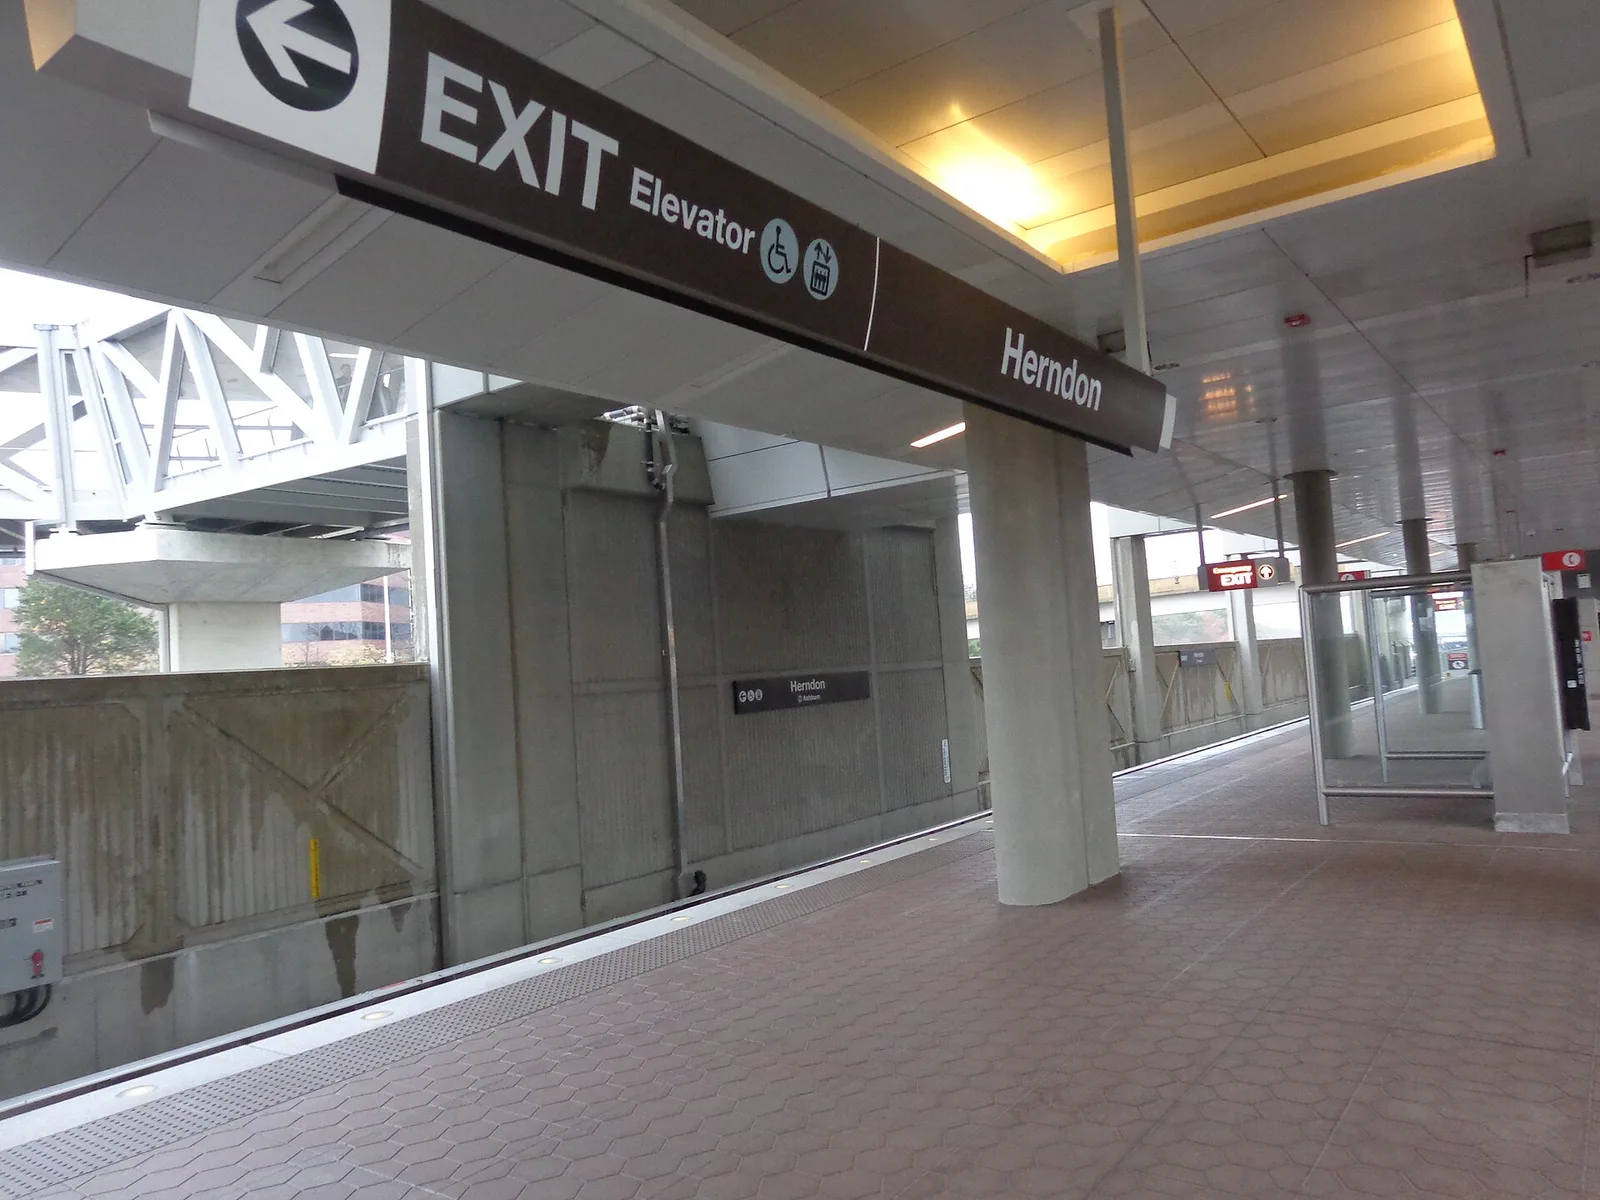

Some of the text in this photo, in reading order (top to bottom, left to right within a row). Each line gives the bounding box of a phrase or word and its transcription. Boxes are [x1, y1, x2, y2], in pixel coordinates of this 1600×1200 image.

[420, 51, 756, 254] EXIT Elevator
[1000, 327, 1102, 411] Herndon
[1220, 572, 1253, 586] EXIT
[790, 678, 826, 692] Herndon
